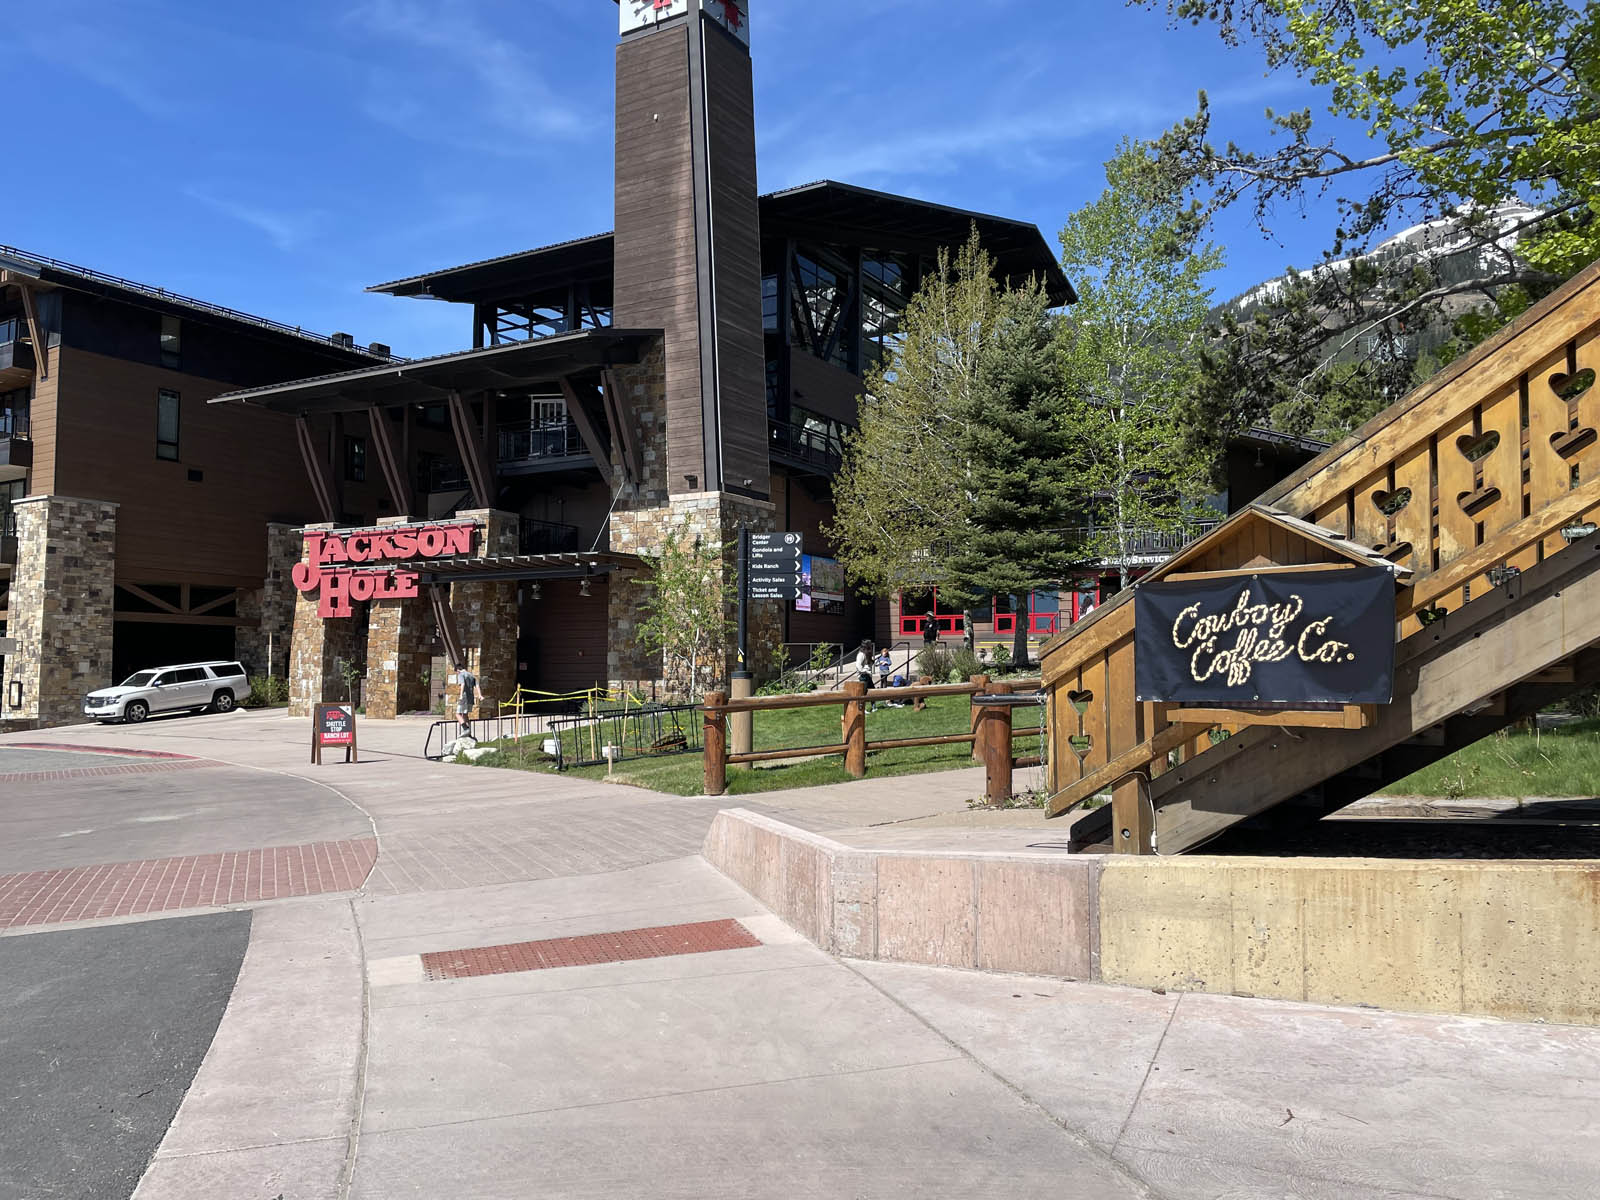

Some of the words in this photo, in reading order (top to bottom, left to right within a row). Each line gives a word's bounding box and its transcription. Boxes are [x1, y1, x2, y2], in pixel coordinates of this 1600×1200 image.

[292, 524, 475, 591] JACKSON
[1132, 555, 1172, 564] SERVICE
[317, 569, 418, 618] HOLE
[1172, 589, 1303, 649] Cowboy
[1190, 628, 1295, 687] Coffee
